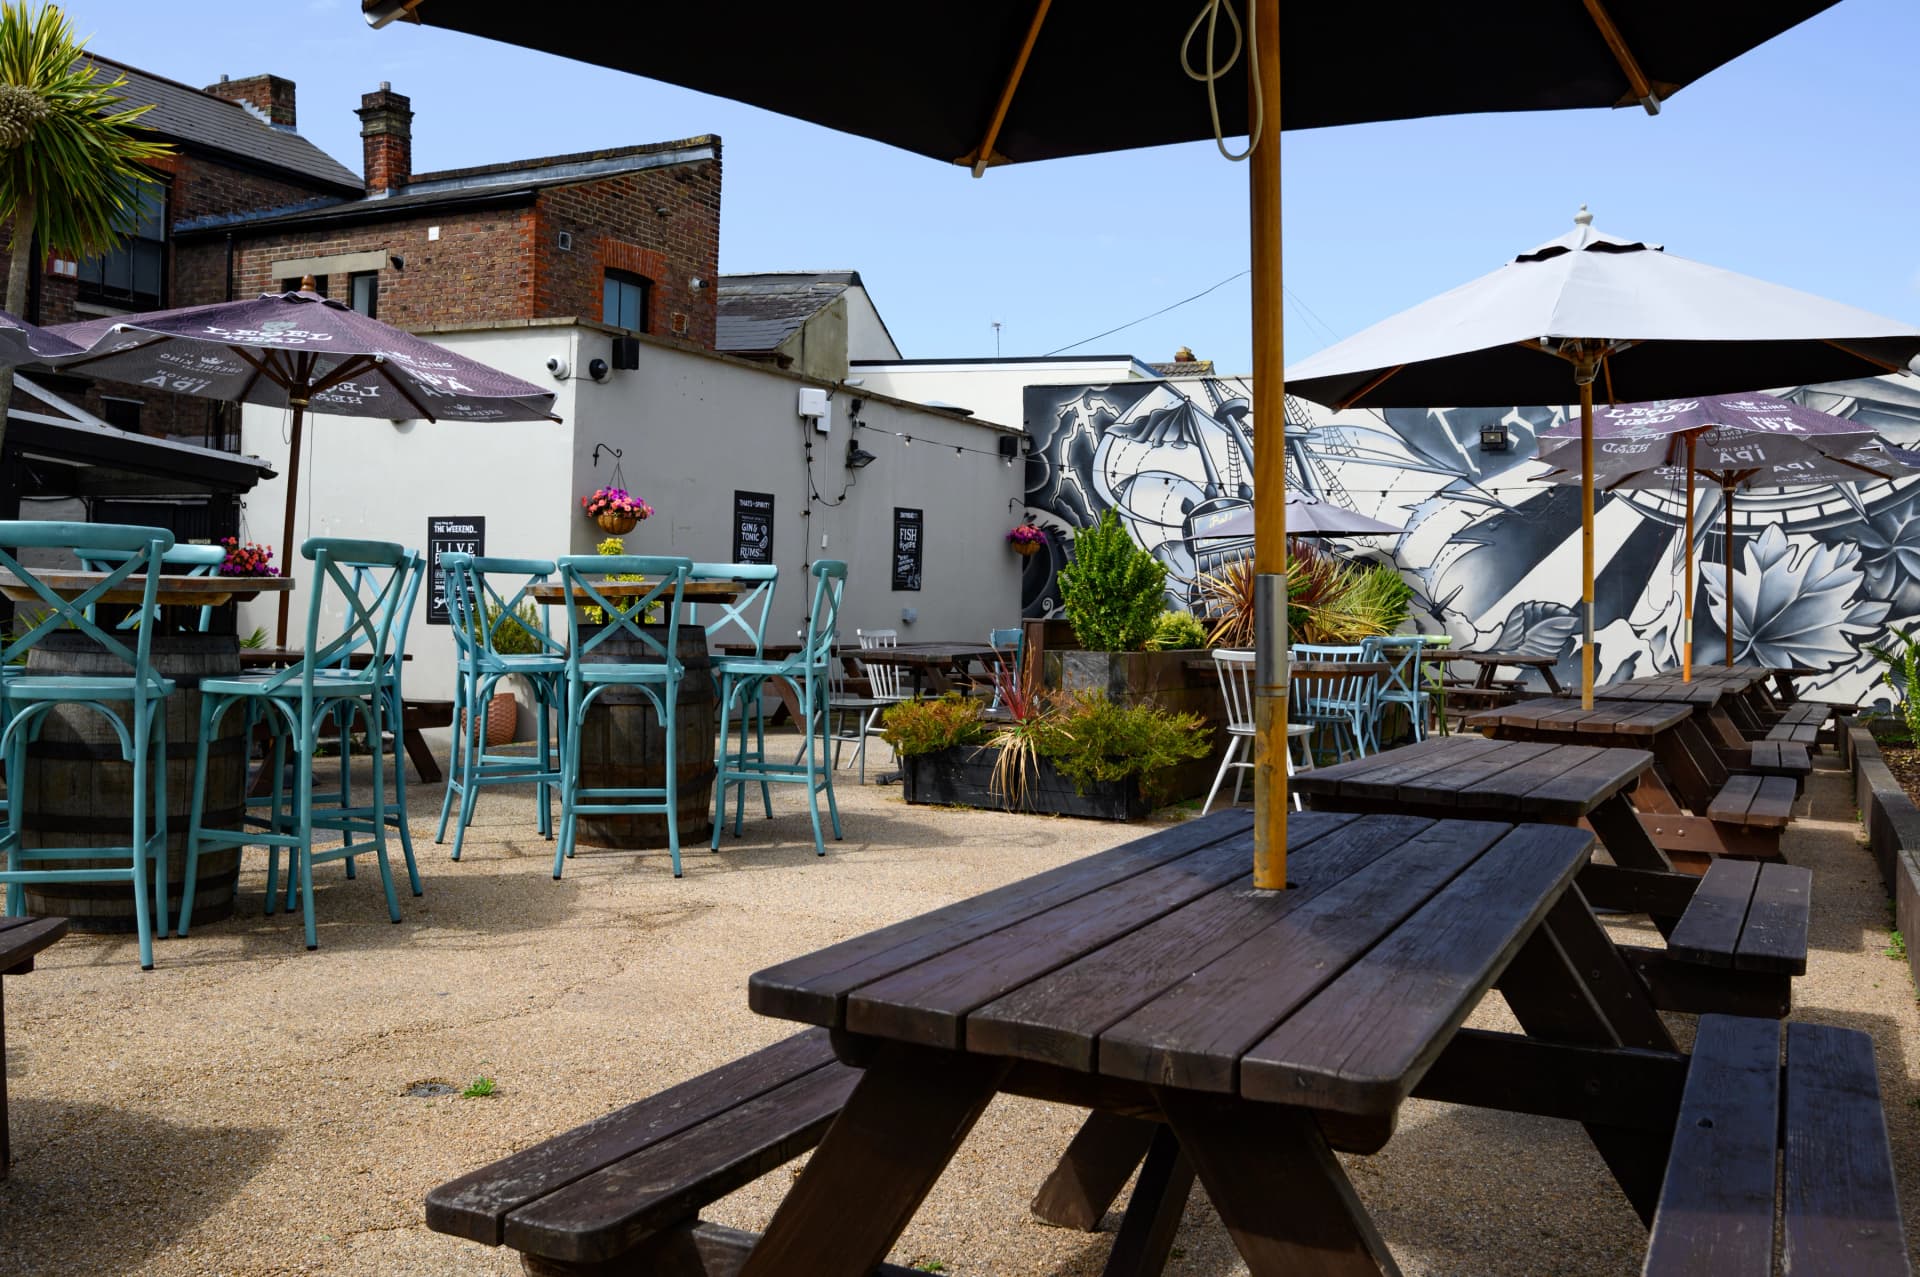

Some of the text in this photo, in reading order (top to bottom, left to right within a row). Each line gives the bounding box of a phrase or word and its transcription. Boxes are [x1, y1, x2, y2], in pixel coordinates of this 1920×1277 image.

[1752, 419, 1806, 431] IPA
[434, 525, 445, 533] THE
[900, 528, 917, 541] FISH
[742, 532, 760, 542] TONIC
[436, 542, 475, 554] LIVE
[740, 547, 760, 559] RUMS
